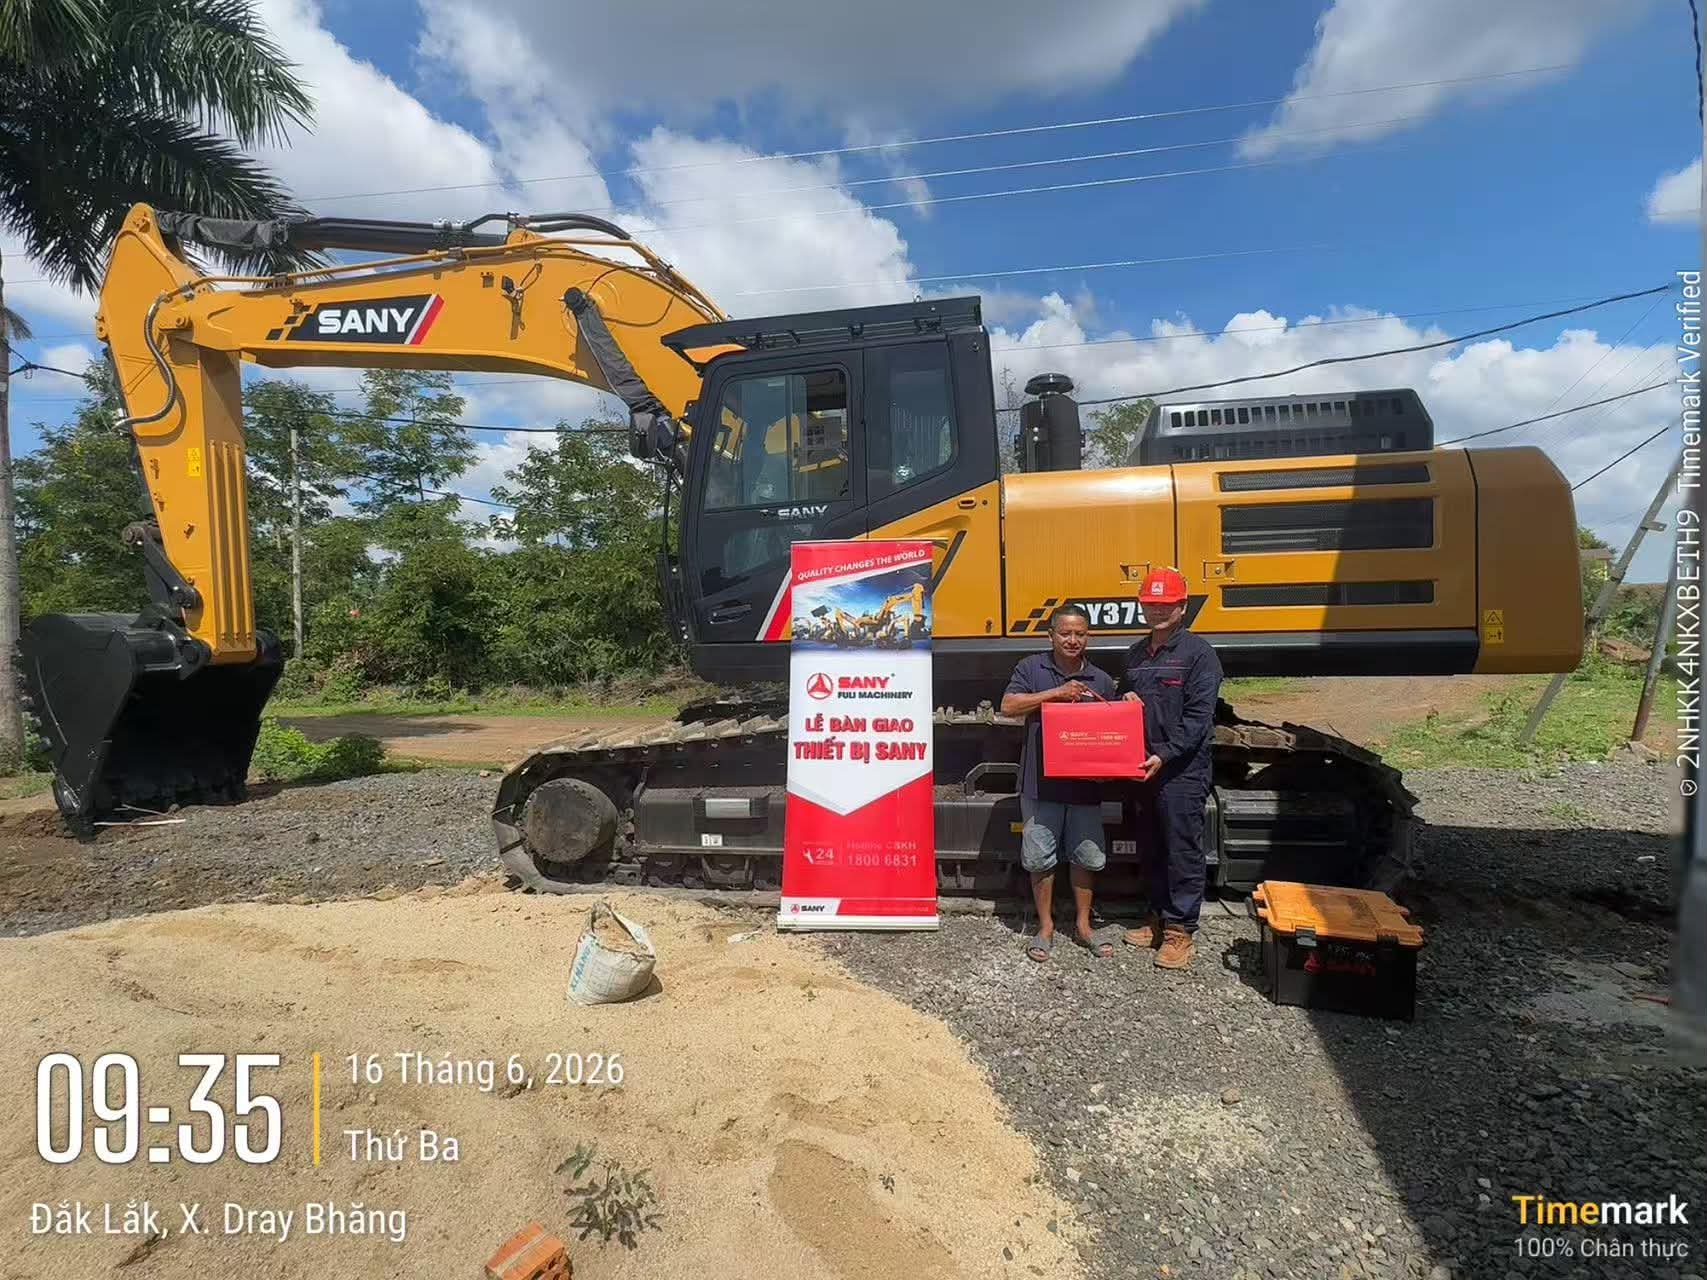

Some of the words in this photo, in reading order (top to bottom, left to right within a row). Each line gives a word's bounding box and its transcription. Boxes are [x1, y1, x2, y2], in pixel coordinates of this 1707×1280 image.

[318, 308, 415, 334] SANY
[778, 505, 828, 517] SANY
[797, 565, 833, 581] QUALITY
[834, 559, 875, 574] CHANGES
[876, 555, 893, 567] THE
[893, 549, 926, 562] WORLD
[1073, 601, 1147, 625] Y37
[838, 676, 890, 689] SANY
[838, 691, 857, 699] FULI
[858, 691, 913, 699] MACHINERY
[805, 713, 824, 732] LỄ
[829, 715, 867, 732] BÀN
[872, 718, 914, 732] GIAO
[793, 736, 846, 760] THIẾT
[850, 742, 870, 763] BỊ
[875, 741, 928, 760] SANY
[847, 854, 880, 866] 1800
